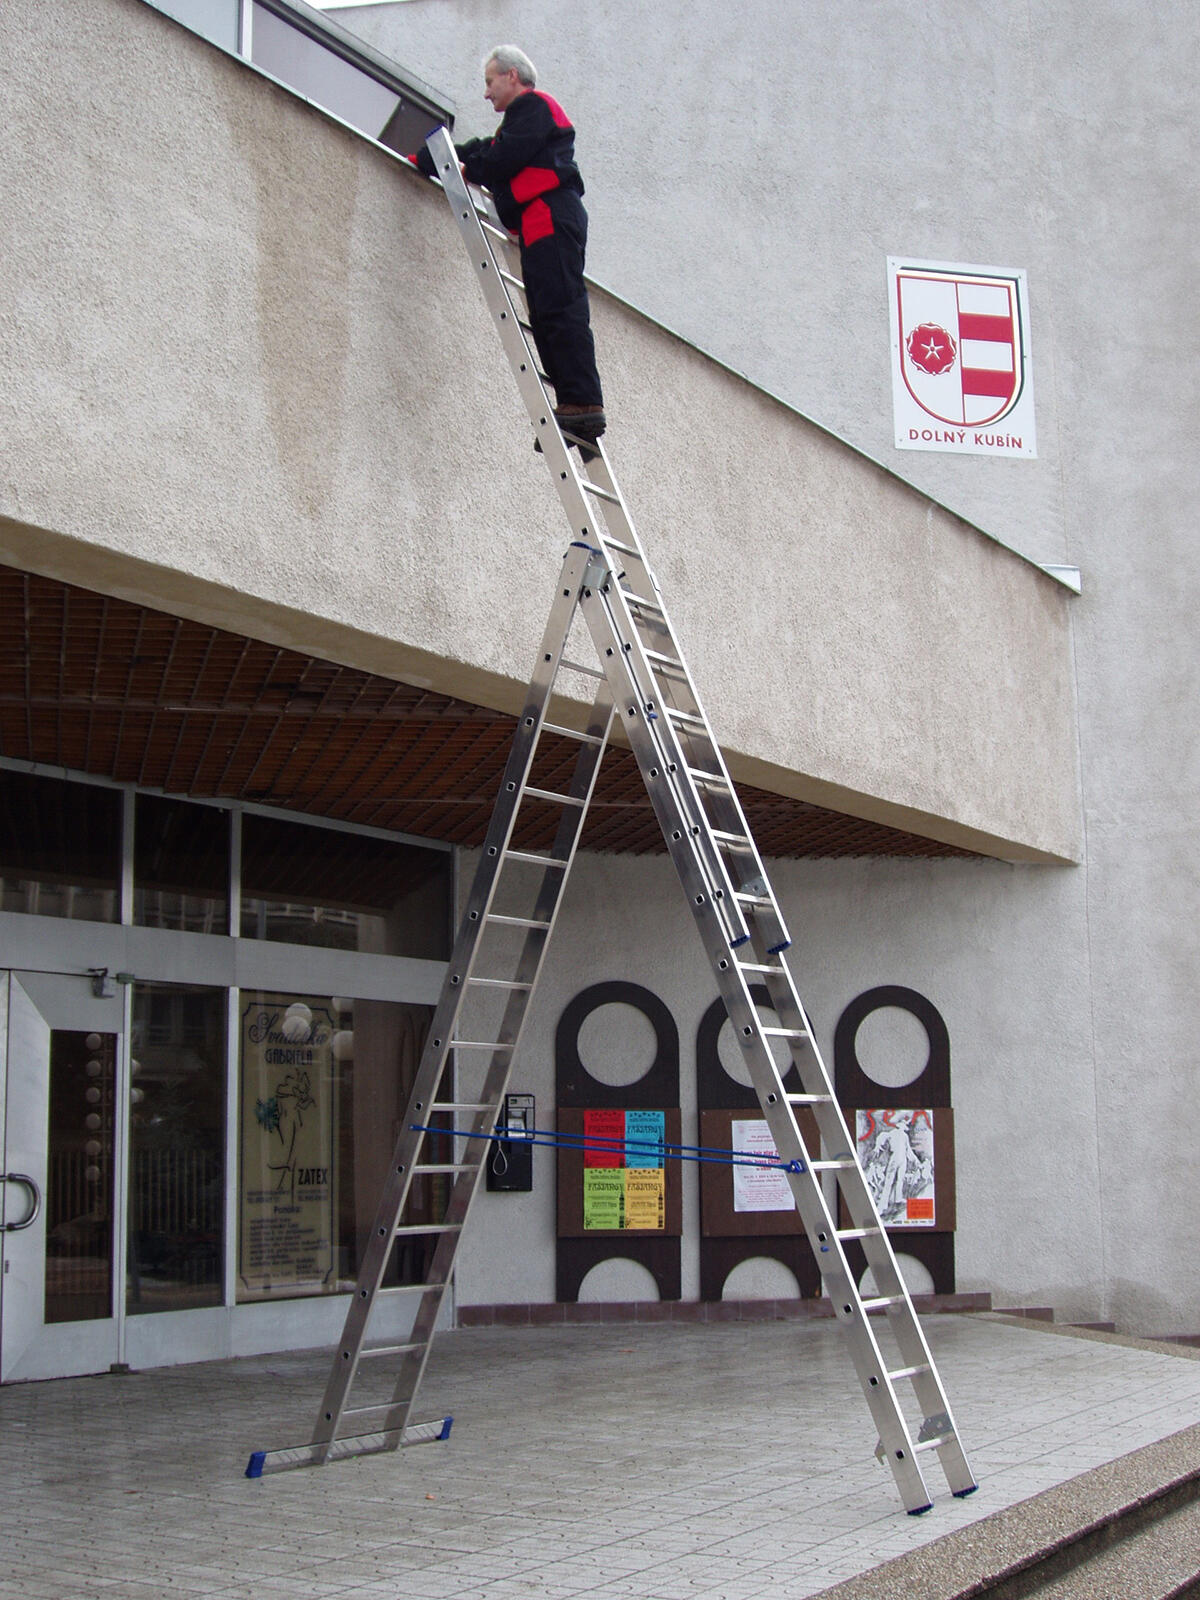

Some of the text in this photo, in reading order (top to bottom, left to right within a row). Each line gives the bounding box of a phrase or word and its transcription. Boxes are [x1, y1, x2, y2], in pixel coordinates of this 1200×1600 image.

[909, 428, 1023, 449] DOLNÝ KUBÍN
[264, 1047, 313, 1066] GABRIELA
[298, 1168, 328, 1185] ZATEX
